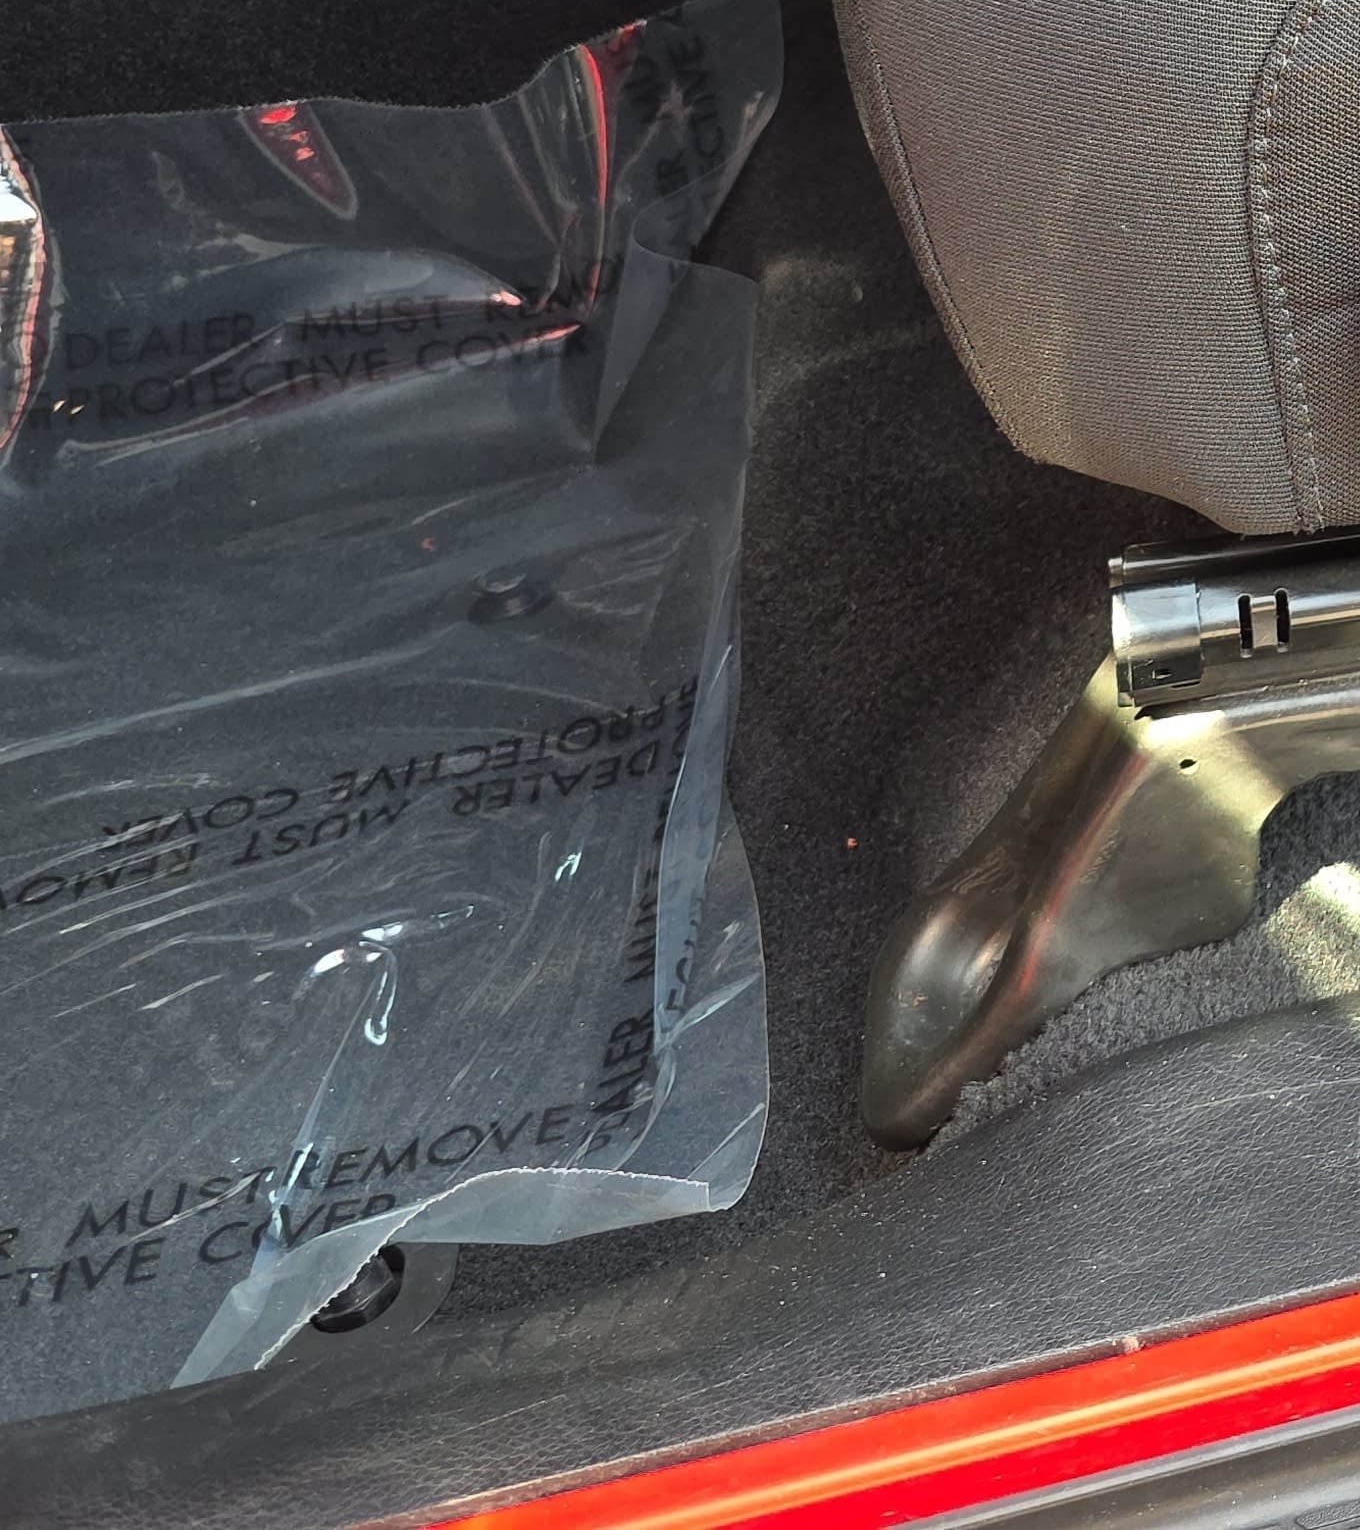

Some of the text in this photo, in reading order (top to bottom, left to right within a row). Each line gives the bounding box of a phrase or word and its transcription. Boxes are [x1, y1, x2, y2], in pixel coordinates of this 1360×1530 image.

[64, 312, 256, 371] DEALER
[300, 295, 448, 342] MUST
[67, 346, 388, 425] PROTECTIVE
[327, 693, 668, 804] PROTECTIVE
[451, 737, 661, 816] DEALER
[102, 787, 299, 856] COVER
[231, 799, 411, 866] MUST
[65, 1103, 575, 1248] MUST REMOVE
